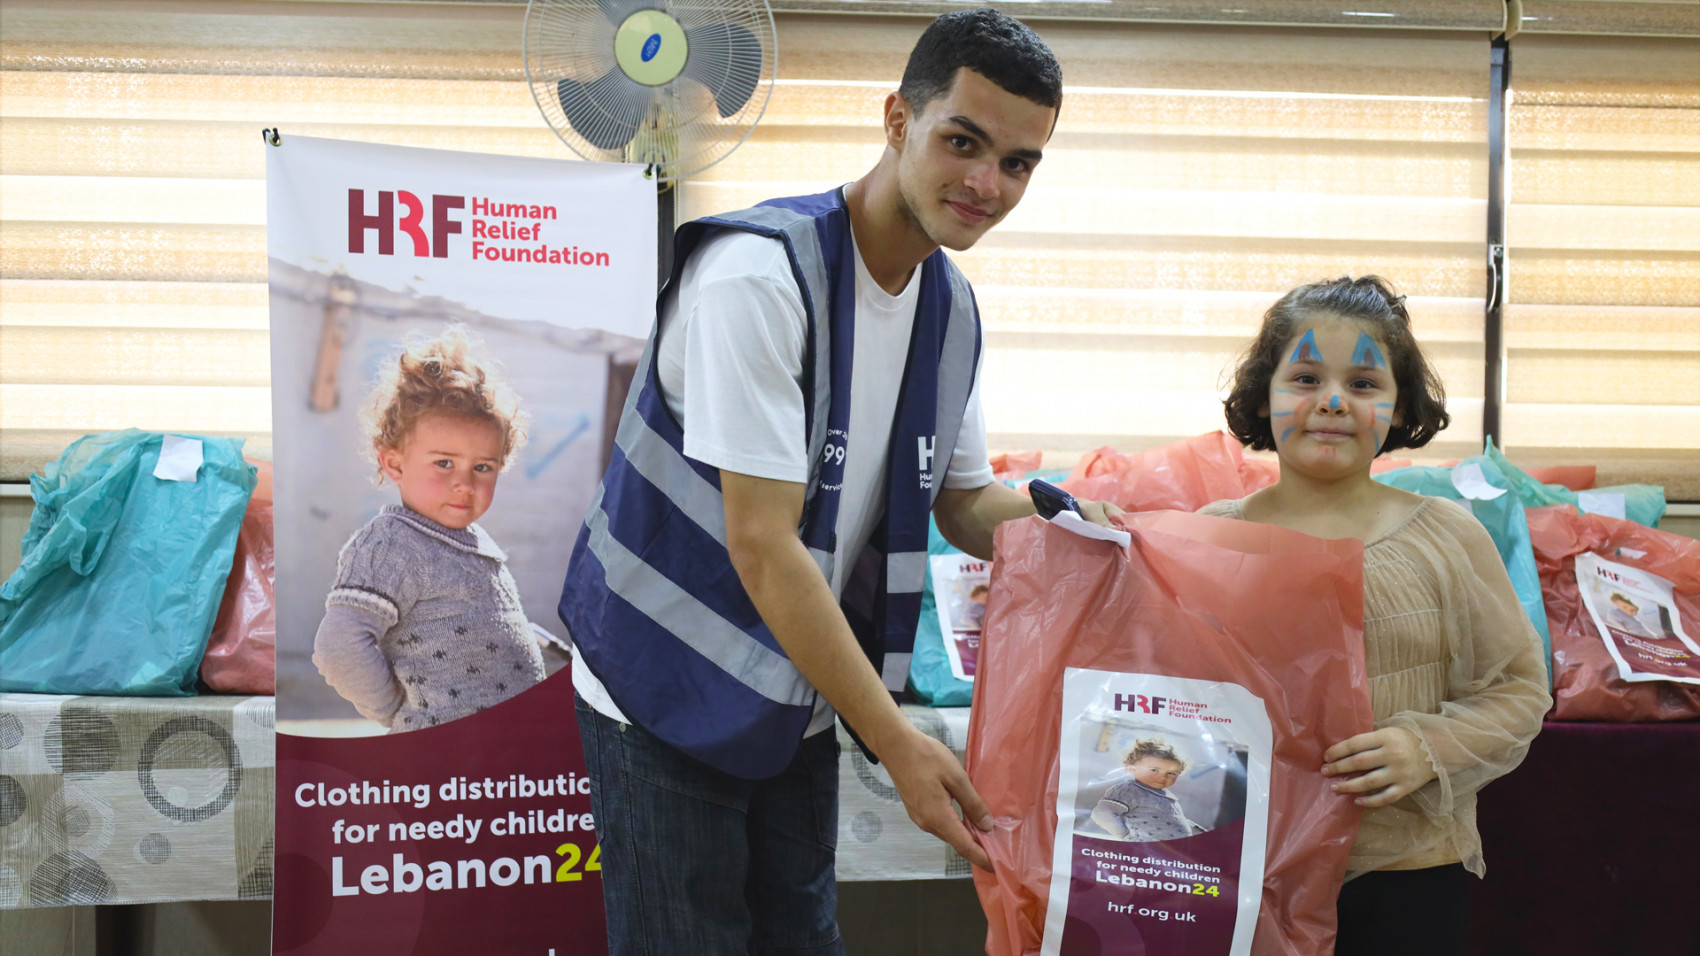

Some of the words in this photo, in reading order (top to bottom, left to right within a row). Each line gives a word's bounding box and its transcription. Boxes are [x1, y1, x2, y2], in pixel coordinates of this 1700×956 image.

[472, 197, 557, 220] Human
[348, 188, 465, 258] HRF
[472, 219, 541, 241] Relief
[472, 241, 610, 266] Foundation
[824, 444, 845, 465] 99
[959, 563, 987, 573] HRF
[1597, 566, 1620, 581] HRF
[1114, 693, 1166, 715] HRF
[1169, 698, 1208, 709] Human
[1169, 705, 1200, 714] Relief
[1169, 711, 1232, 723] Foundation
[295, 780, 430, 808] Clothing
[439, 772, 591, 801] distributio
[332, 820, 380, 844] for
[389, 814, 483, 844] needy
[490, 809, 595, 836] childre
[1081, 848, 1139, 864] Clothing
[1142, 857, 1221, 873] distribution
[1096, 861, 1117, 870] for
[1120, 864, 1161, 877] needy
[1164, 869, 1221, 883] children
[1096, 870, 1220, 897] Lebanon24
[1107, 901, 1197, 923] hrf.org.uk
